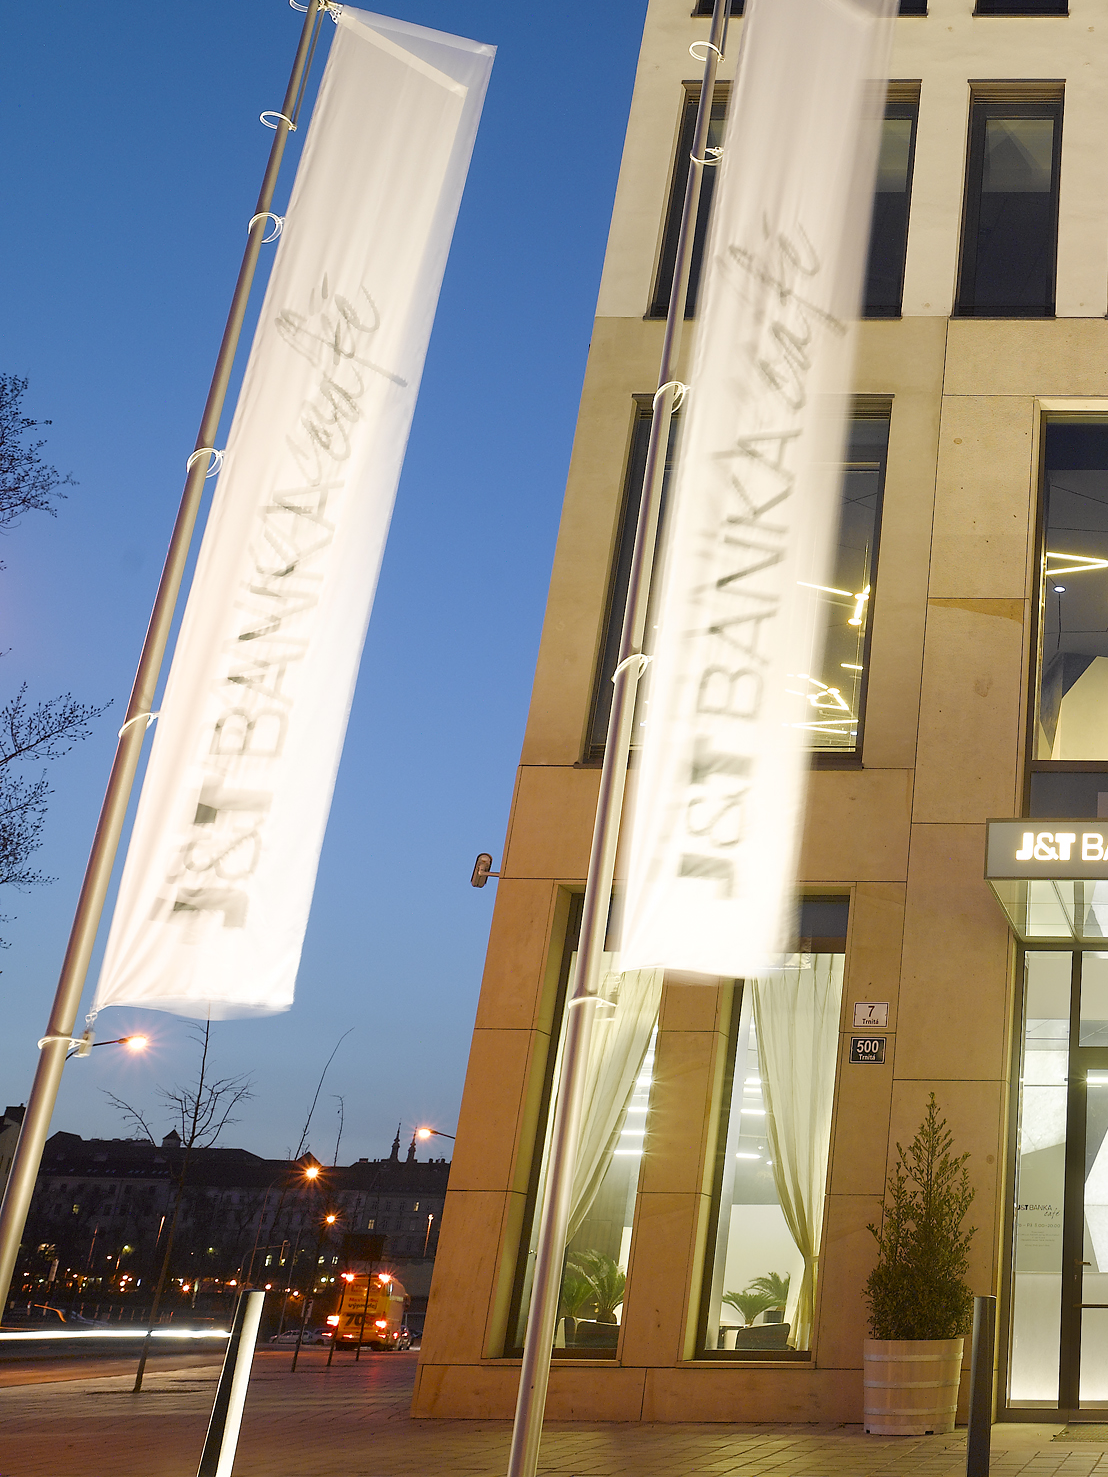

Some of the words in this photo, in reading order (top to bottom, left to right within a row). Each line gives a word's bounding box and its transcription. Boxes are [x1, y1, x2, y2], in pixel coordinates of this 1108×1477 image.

[692, 427, 803, 718] BANKA
[1015, 832, 1076, 862] J&T
[868, 1005, 875, 1018] 7
[856, 1040, 879, 1053] 500
[858, 1053, 876, 1061] Trnitá
